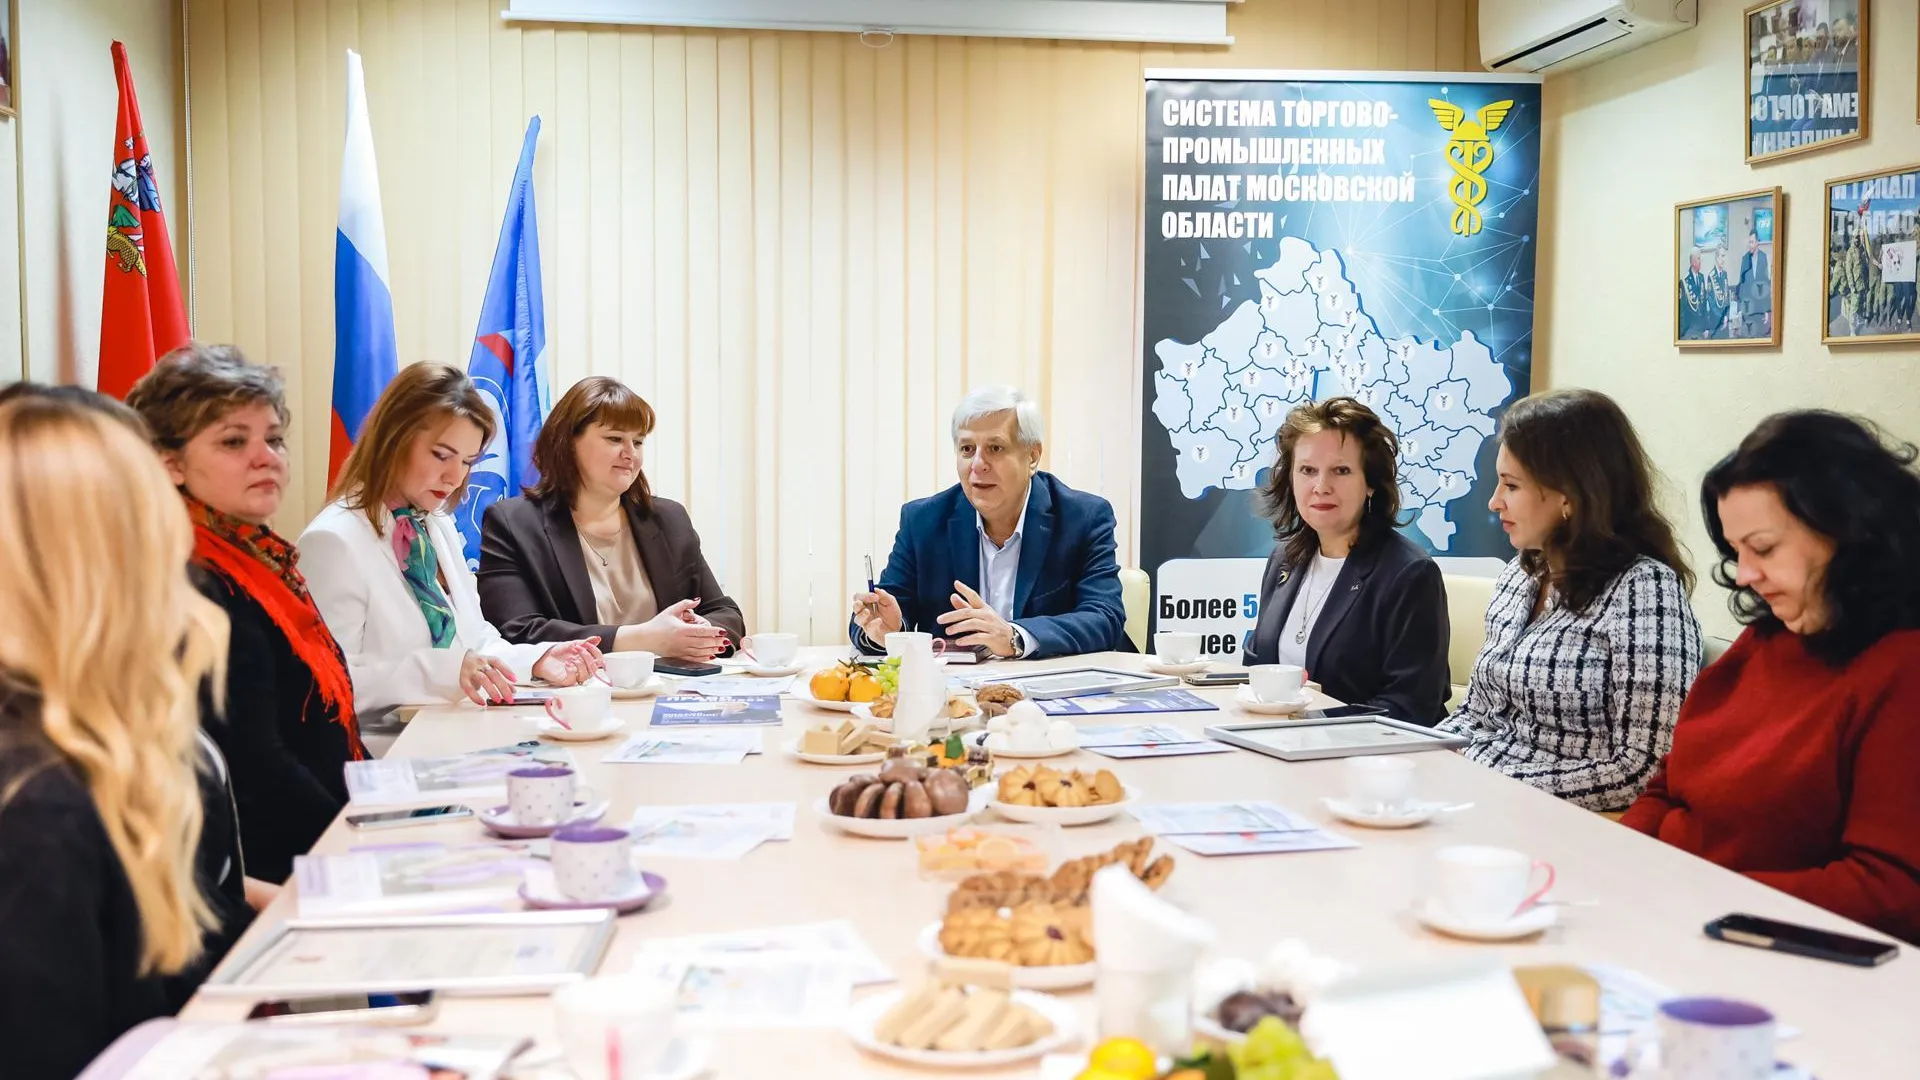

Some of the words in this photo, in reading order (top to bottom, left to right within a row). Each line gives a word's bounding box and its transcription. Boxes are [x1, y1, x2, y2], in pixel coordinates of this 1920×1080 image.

[1162, 99, 1277, 127] СИСТЕМА
[1281, 99, 1399, 127] ТОРГОВО-
[1162, 136, 1385, 164] ПРОМЫШЛЕННЫХ
[1162, 174, 1242, 202] ПАЛАТ
[1246, 170, 1416, 202] МОСКОВСКОЙ
[1161, 211, 1274, 239] ОБЛАСТИ
[1159, 594, 1237, 620] Более
